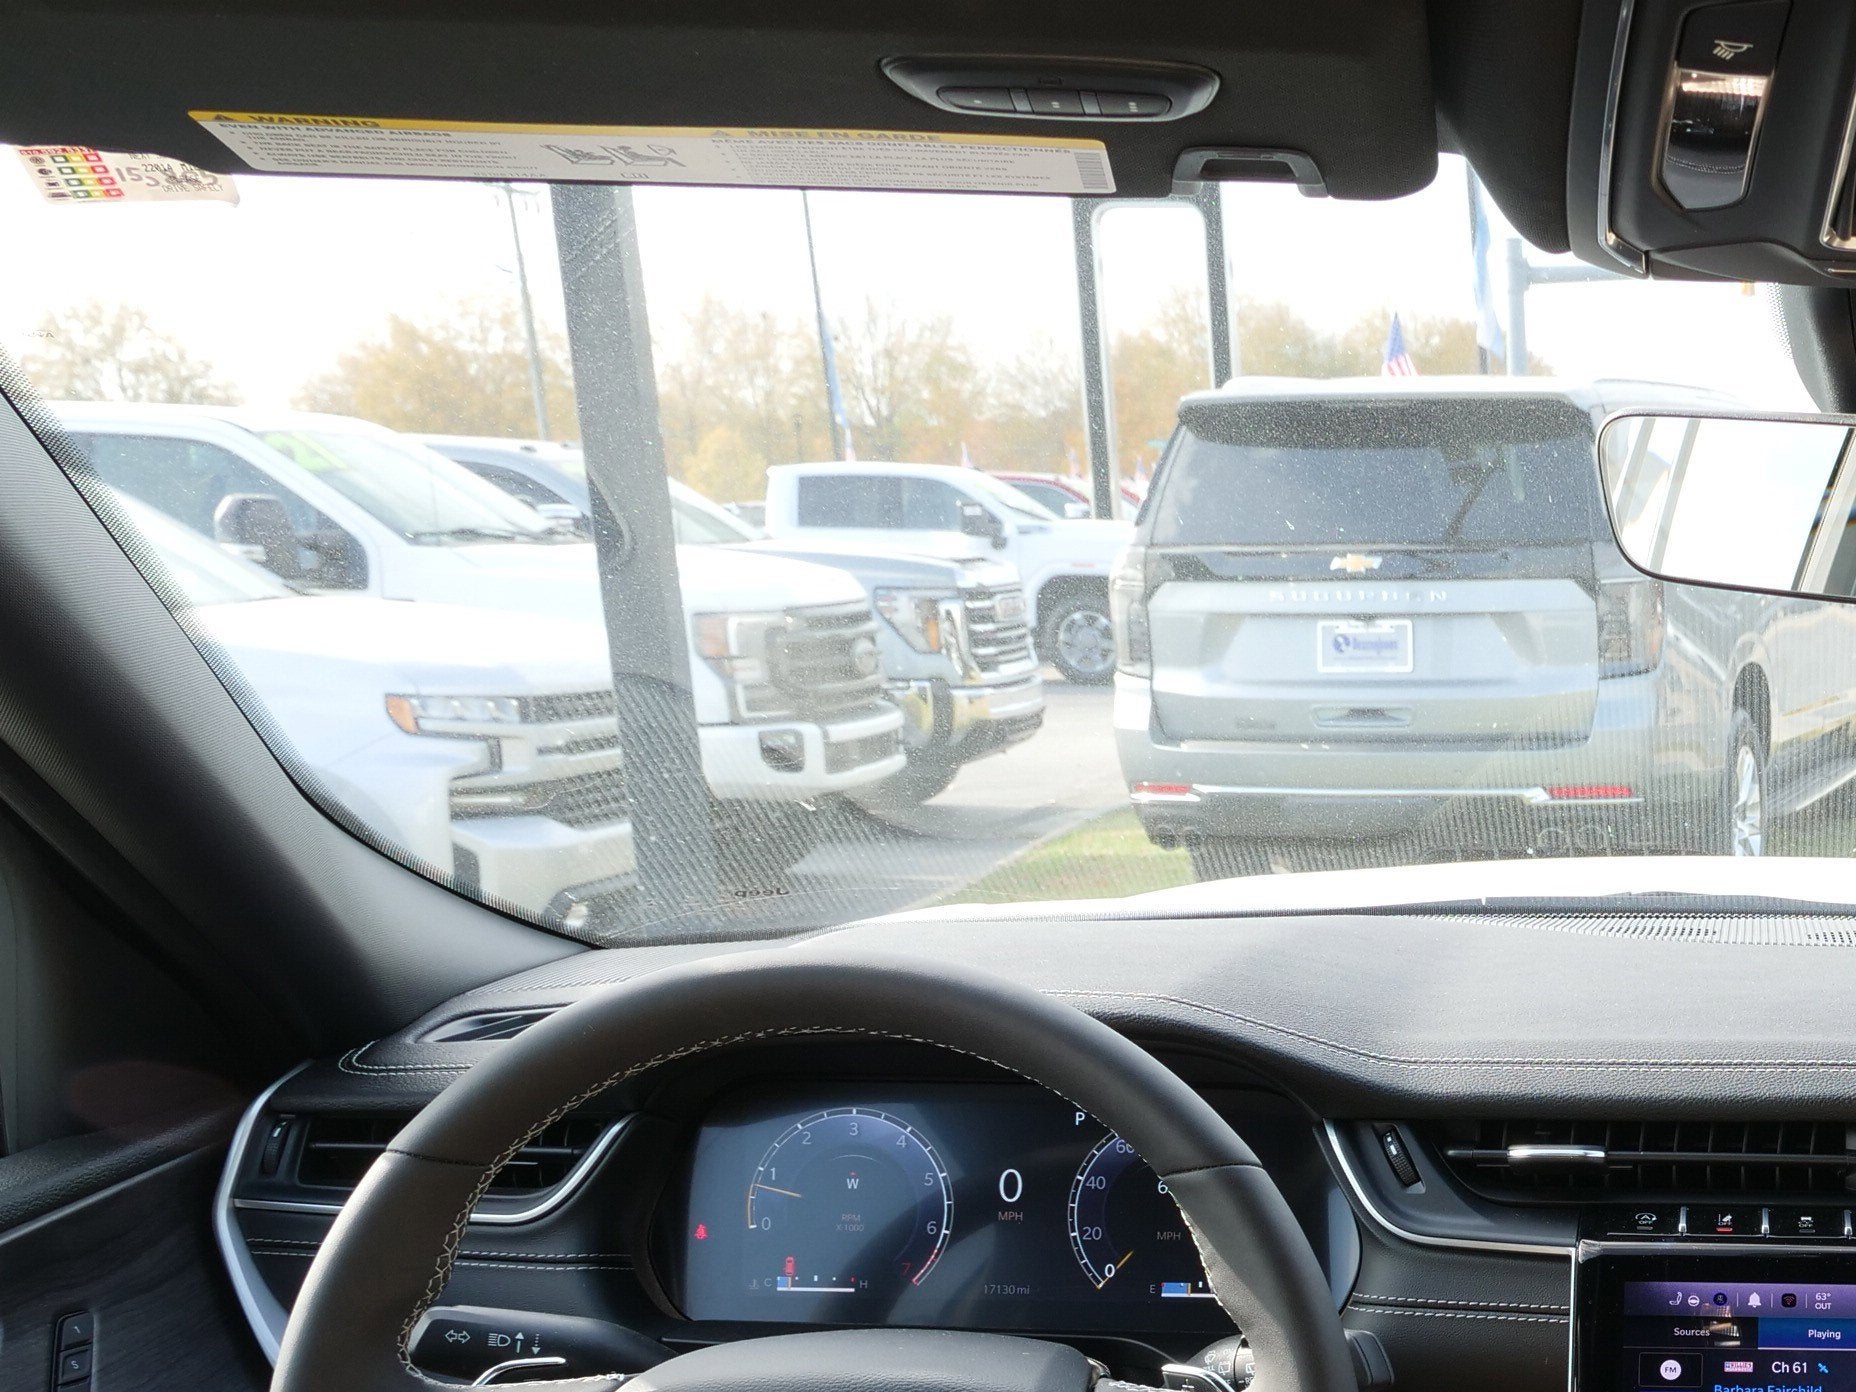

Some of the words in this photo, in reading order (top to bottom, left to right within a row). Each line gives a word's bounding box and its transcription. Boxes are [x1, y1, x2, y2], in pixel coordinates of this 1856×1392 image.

[1075, 1112, 1086, 1126] P
[850, 1122, 859, 1136] 3
[802, 1131, 811, 1145] 2
[896, 1134, 908, 1148] 4
[769, 1167, 777, 1181] 1
[924, 1172, 934, 1186] 5
[846, 1178, 860, 1190] W
[999, 1169, 1023, 1203] 0
[1086, 1176, 1106, 1190] 40
[841, 1213, 862, 1223] RPM
[998, 1211, 1024, 1222] MPH
[761, 1217, 771, 1231] 0
[927, 1221, 937, 1235] 6
[1082, 1227, 1102, 1241] 20
[1157, 1232, 1181, 1241] MPH
[1104, 1264, 1116, 1278] 0
[860, 1280, 868, 1289] H
[1815, 1292, 1831, 1301] 63°
[1815, 1302, 1832, 1310] OUT
[74, 1325, 80, 1334] 1
[1673, 1327, 1710, 1337] Sources
[1808, 1329, 1841, 1341] Playing
[71, 1360, 79, 1369] S
[1664, 1366, 1677, 1374] FM
[1772, 1362, 1791, 1374] Ch
[1793, 1362, 1808, 1374] 61
